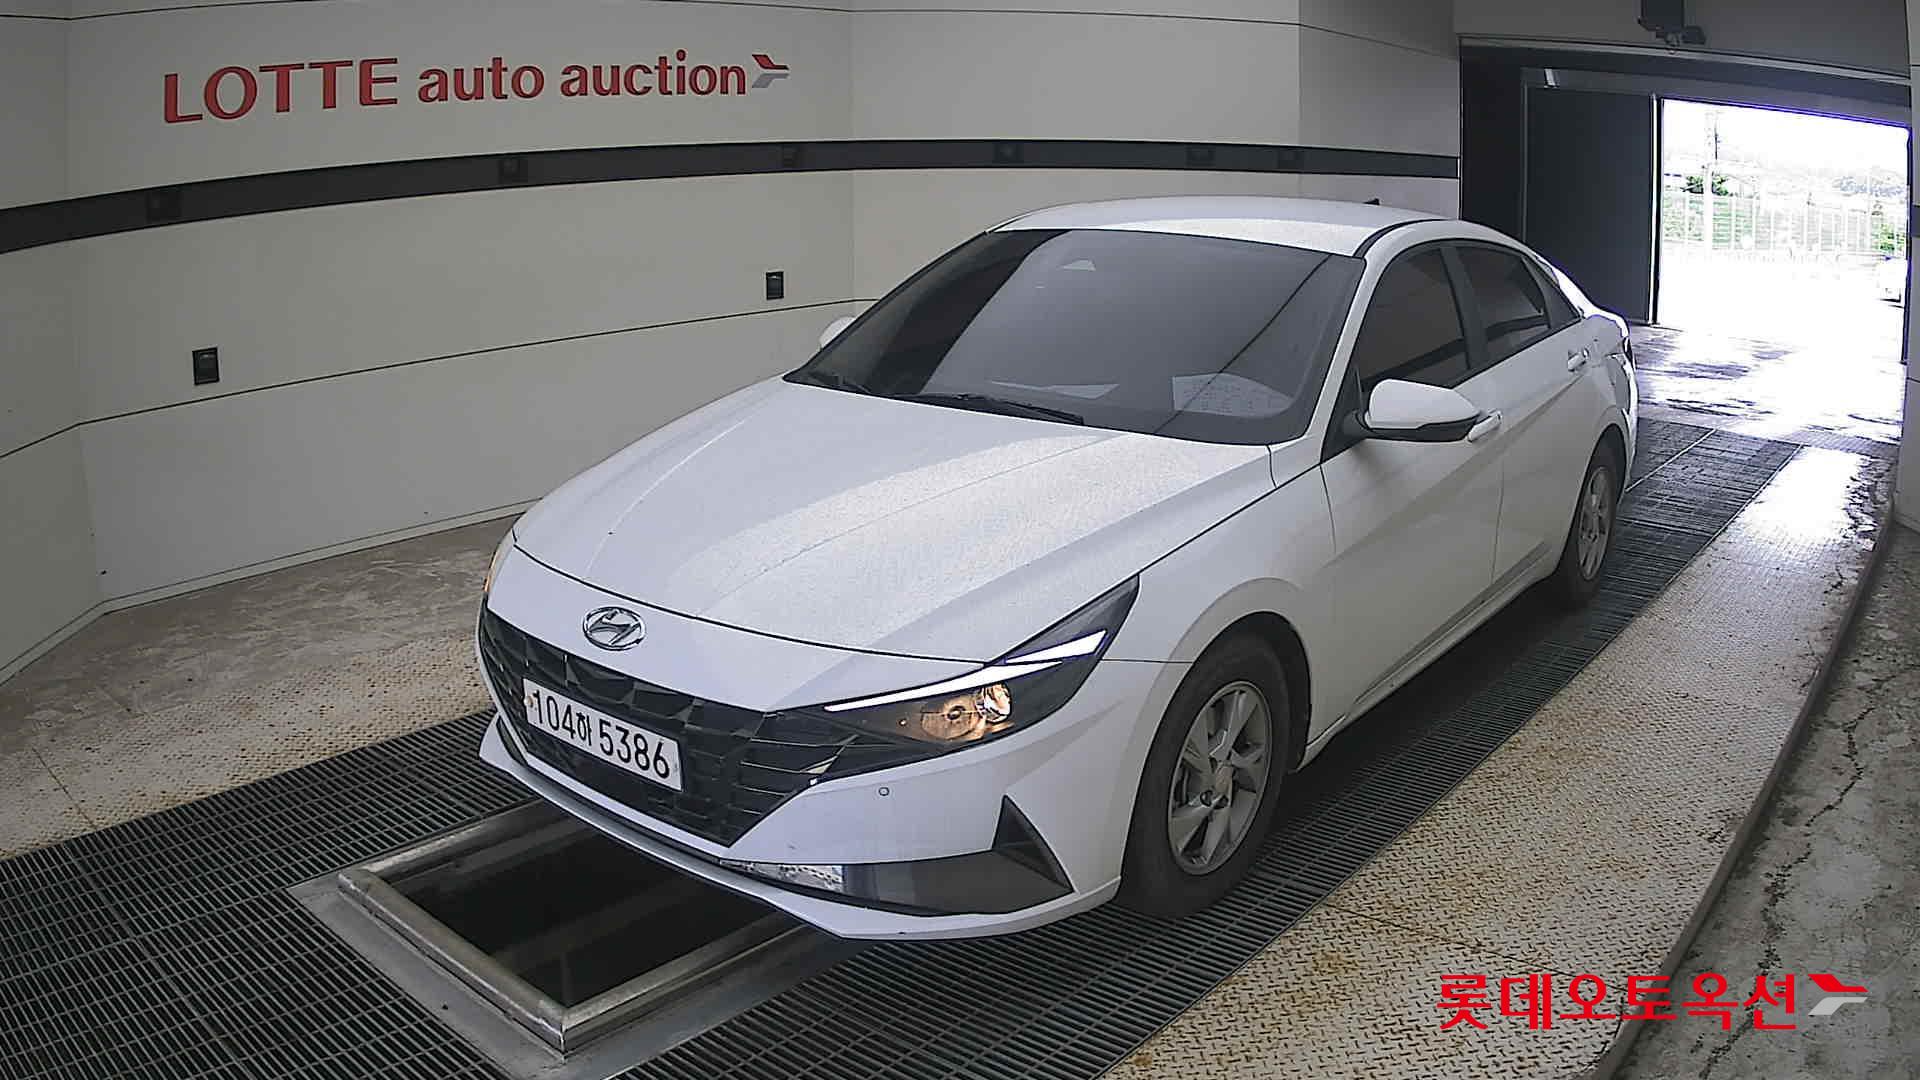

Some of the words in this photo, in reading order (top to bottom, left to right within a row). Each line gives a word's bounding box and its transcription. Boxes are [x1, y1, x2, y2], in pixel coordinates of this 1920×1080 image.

[163, 57, 399, 124] LOTTE
[417, 56, 546, 104] auto
[560, 49, 748, 98] auction
[599, 718, 671, 779] 5386
